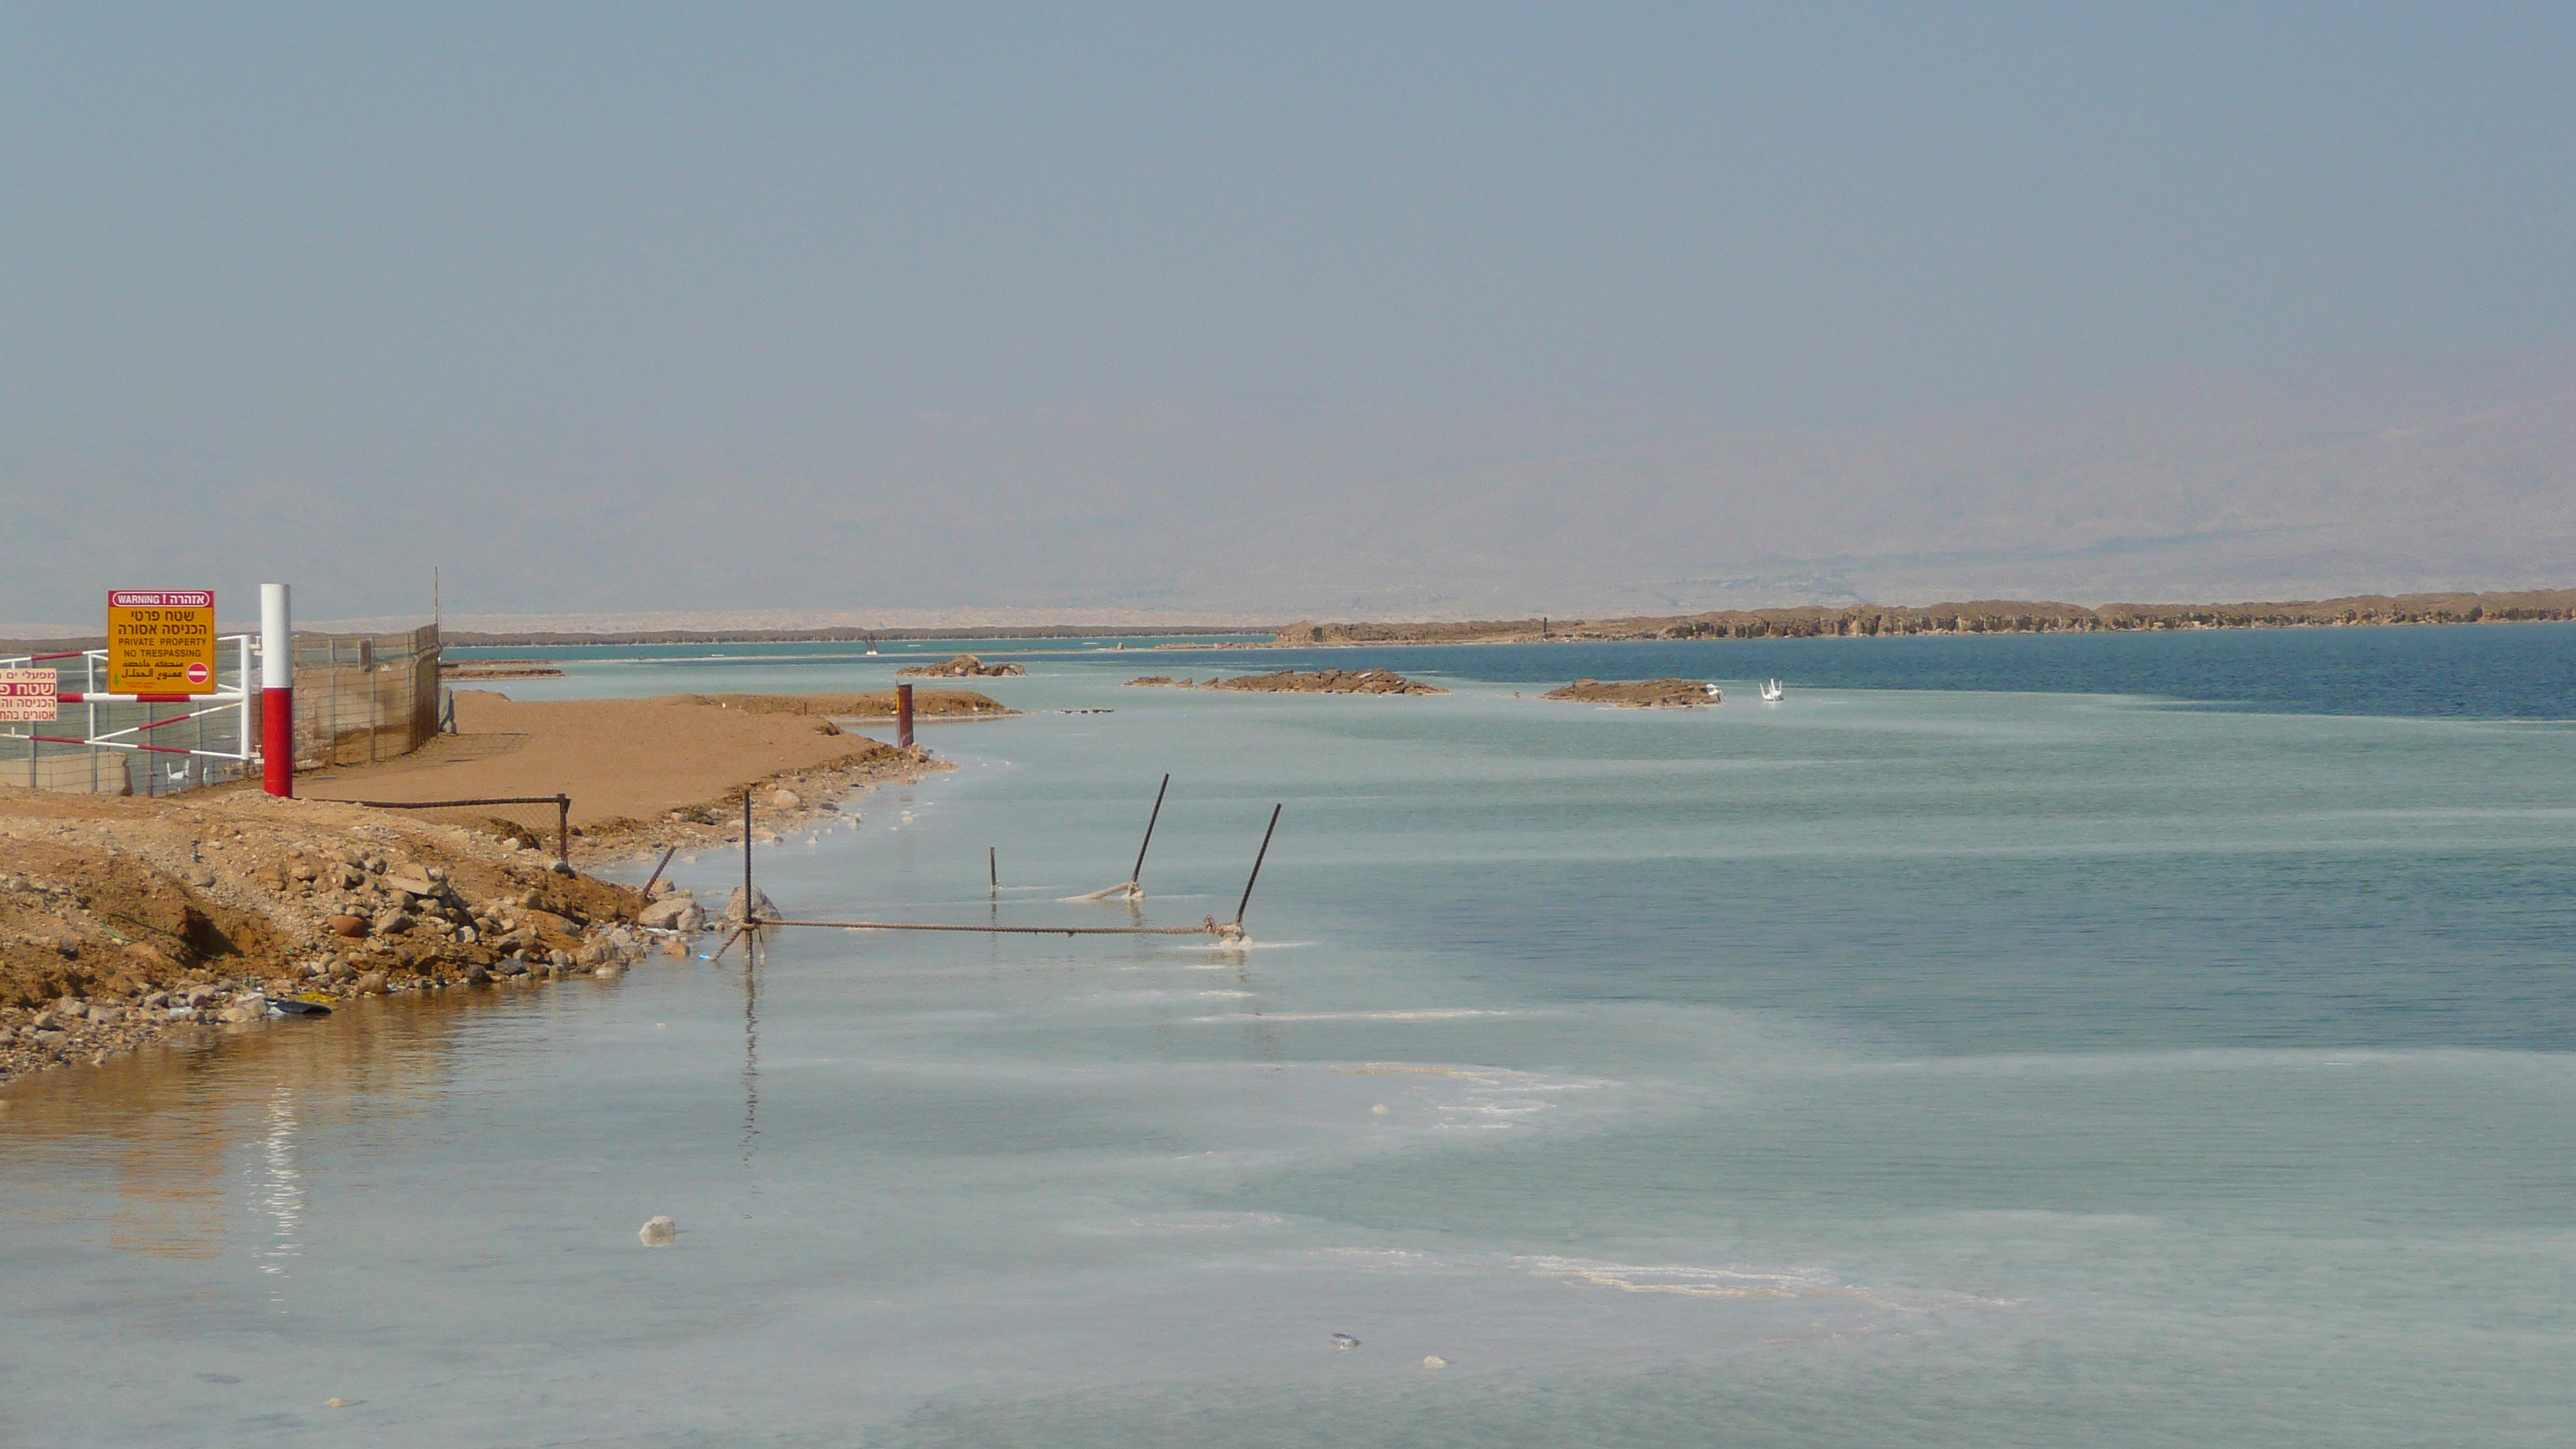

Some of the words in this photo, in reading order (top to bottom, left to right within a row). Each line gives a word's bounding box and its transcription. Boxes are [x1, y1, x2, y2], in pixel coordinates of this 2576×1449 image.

[118, 595, 160, 605] WARNING
[170, 594, 205, 605] אזהרה
[131, 611, 160, 622] פרטי
[165, 611, 194, 622] שטח
[118, 624, 157, 635] אסורה
[162, 624, 207, 635] הכניסה
[118, 638, 155, 646] PRIVATE
[160, 638, 207, 646] PROPERTY
[22, 670, 56, 680] מפעלי
[16, 683, 55, 696] שטח
[17, 698, 56, 707] הכניסה
[23, 711, 56, 720] אסורים
